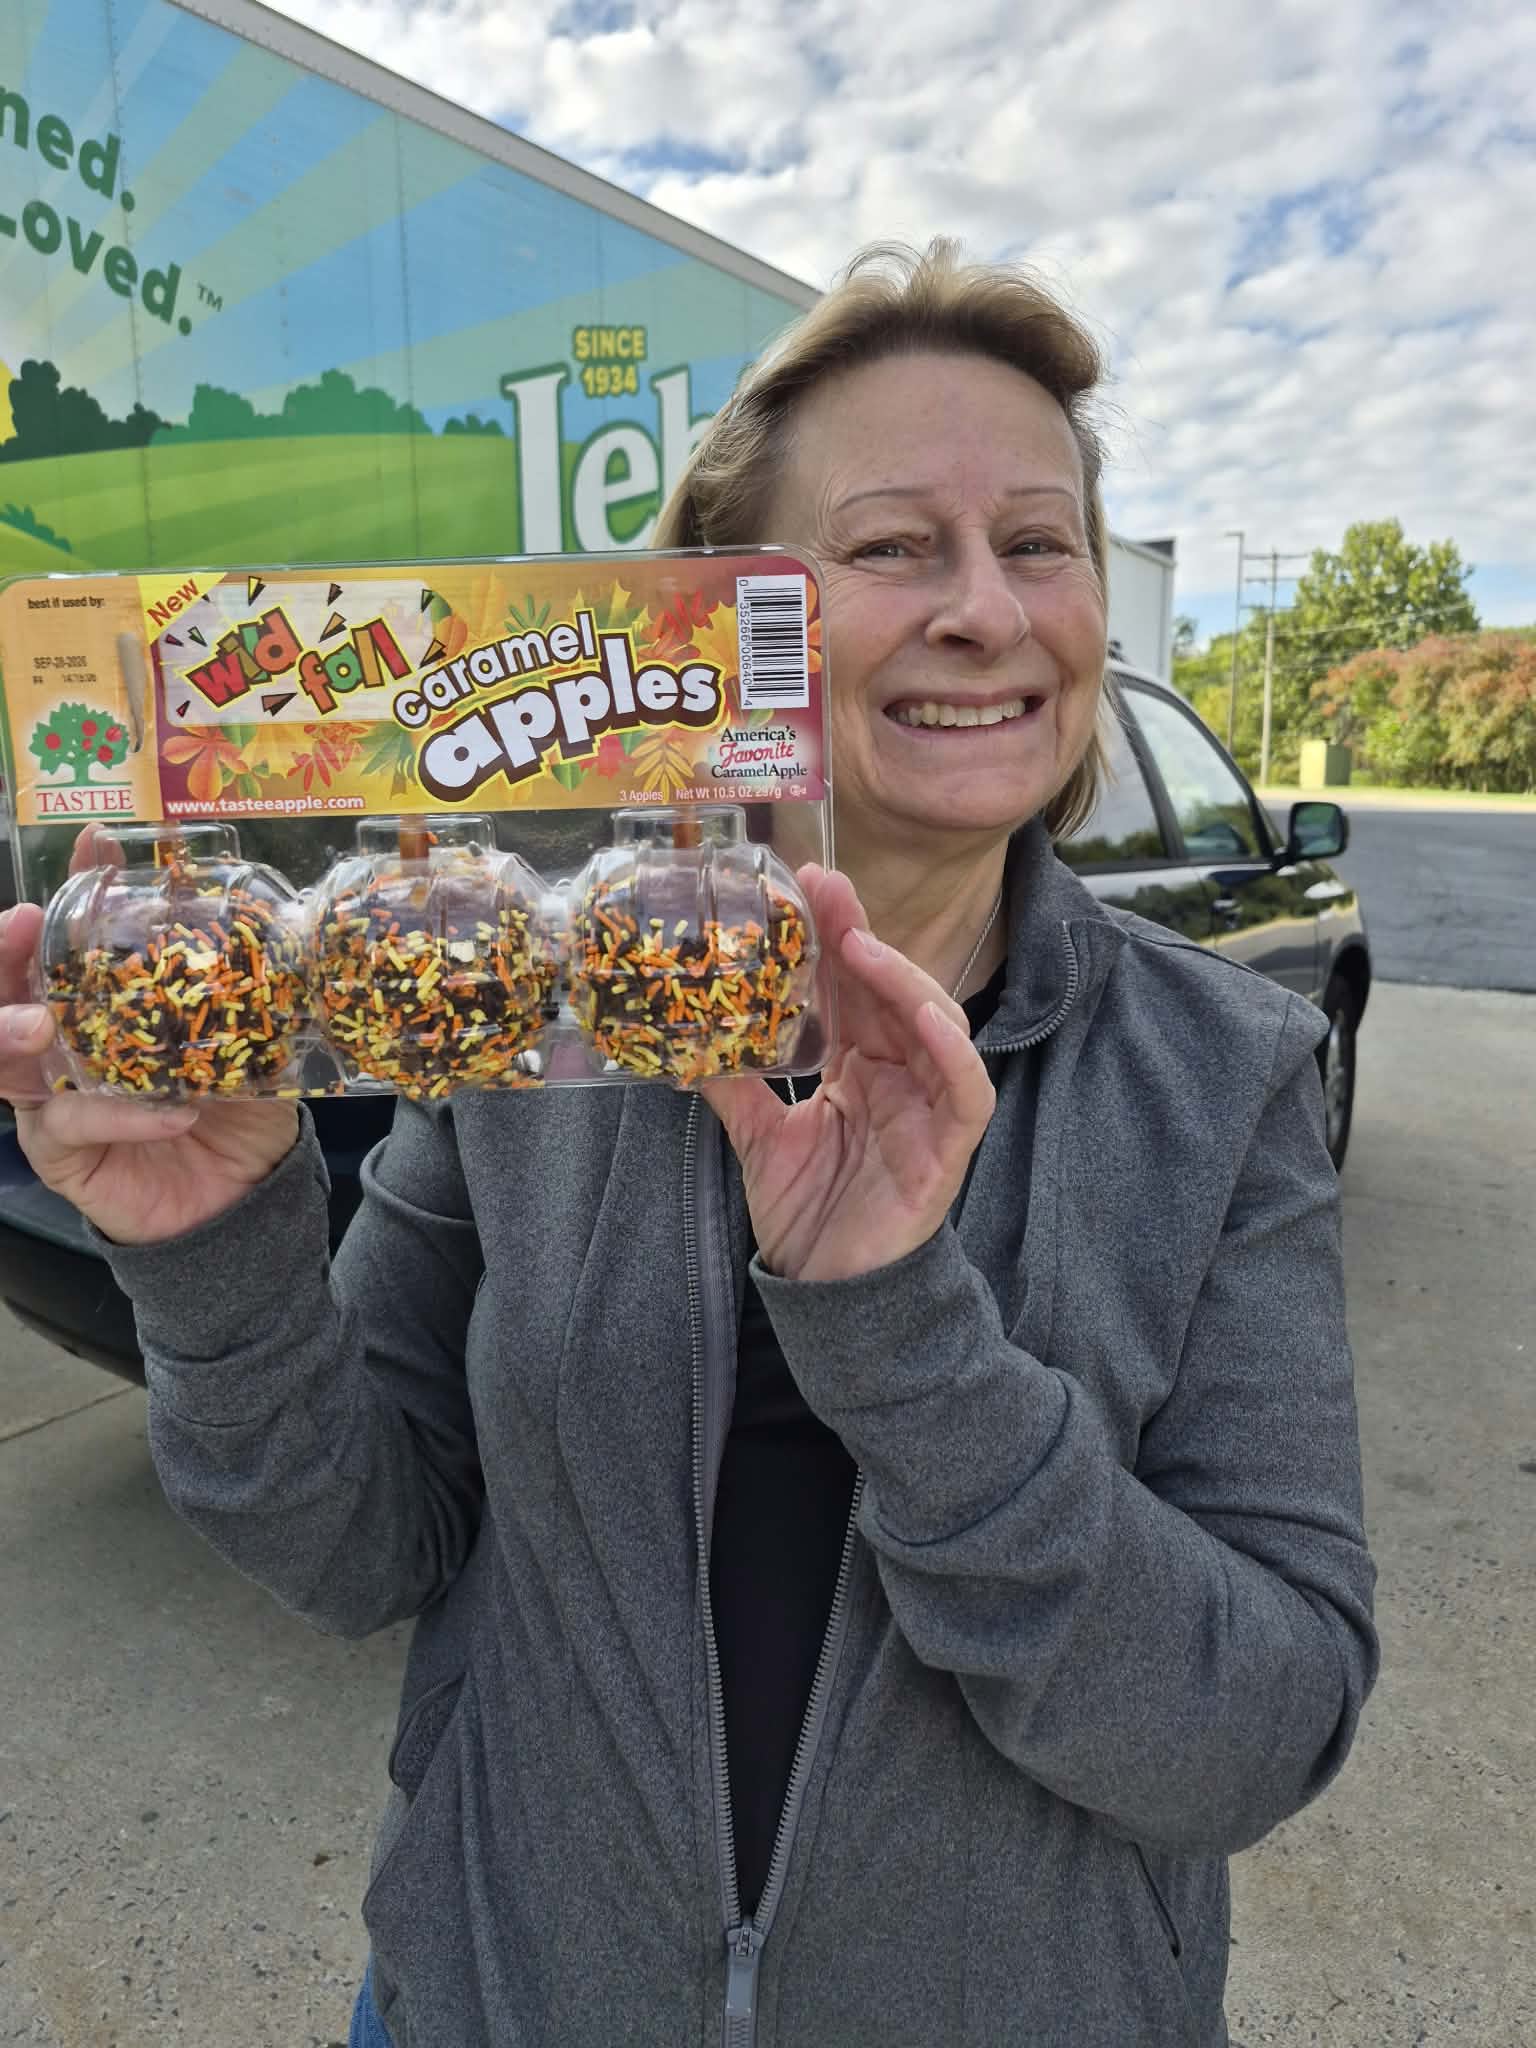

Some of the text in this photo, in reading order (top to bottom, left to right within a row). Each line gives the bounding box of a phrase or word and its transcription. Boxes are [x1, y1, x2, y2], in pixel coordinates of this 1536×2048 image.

[574, 328, 646, 359] SINCE
[583, 366, 637, 395] 1934
[27, 597, 50, 609] best
[62, 596, 87, 608] used
[147, 579, 200, 627] New
[186, 605, 412, 715] wild fall
[395, 611, 597, 727] caramel
[421, 634, 720, 799] apples
[721, 725, 797, 742] America's
[719, 742, 795, 767] Favorite
[36, 788, 134, 812] TASTEE
[167, 796, 365, 815] www.tasteeapple.com
[619, 790, 663, 801] 3 Apples
[676, 788, 694, 799] Net
[695, 788, 709, 799] Wt
[713, 787, 735, 799] 10.5
